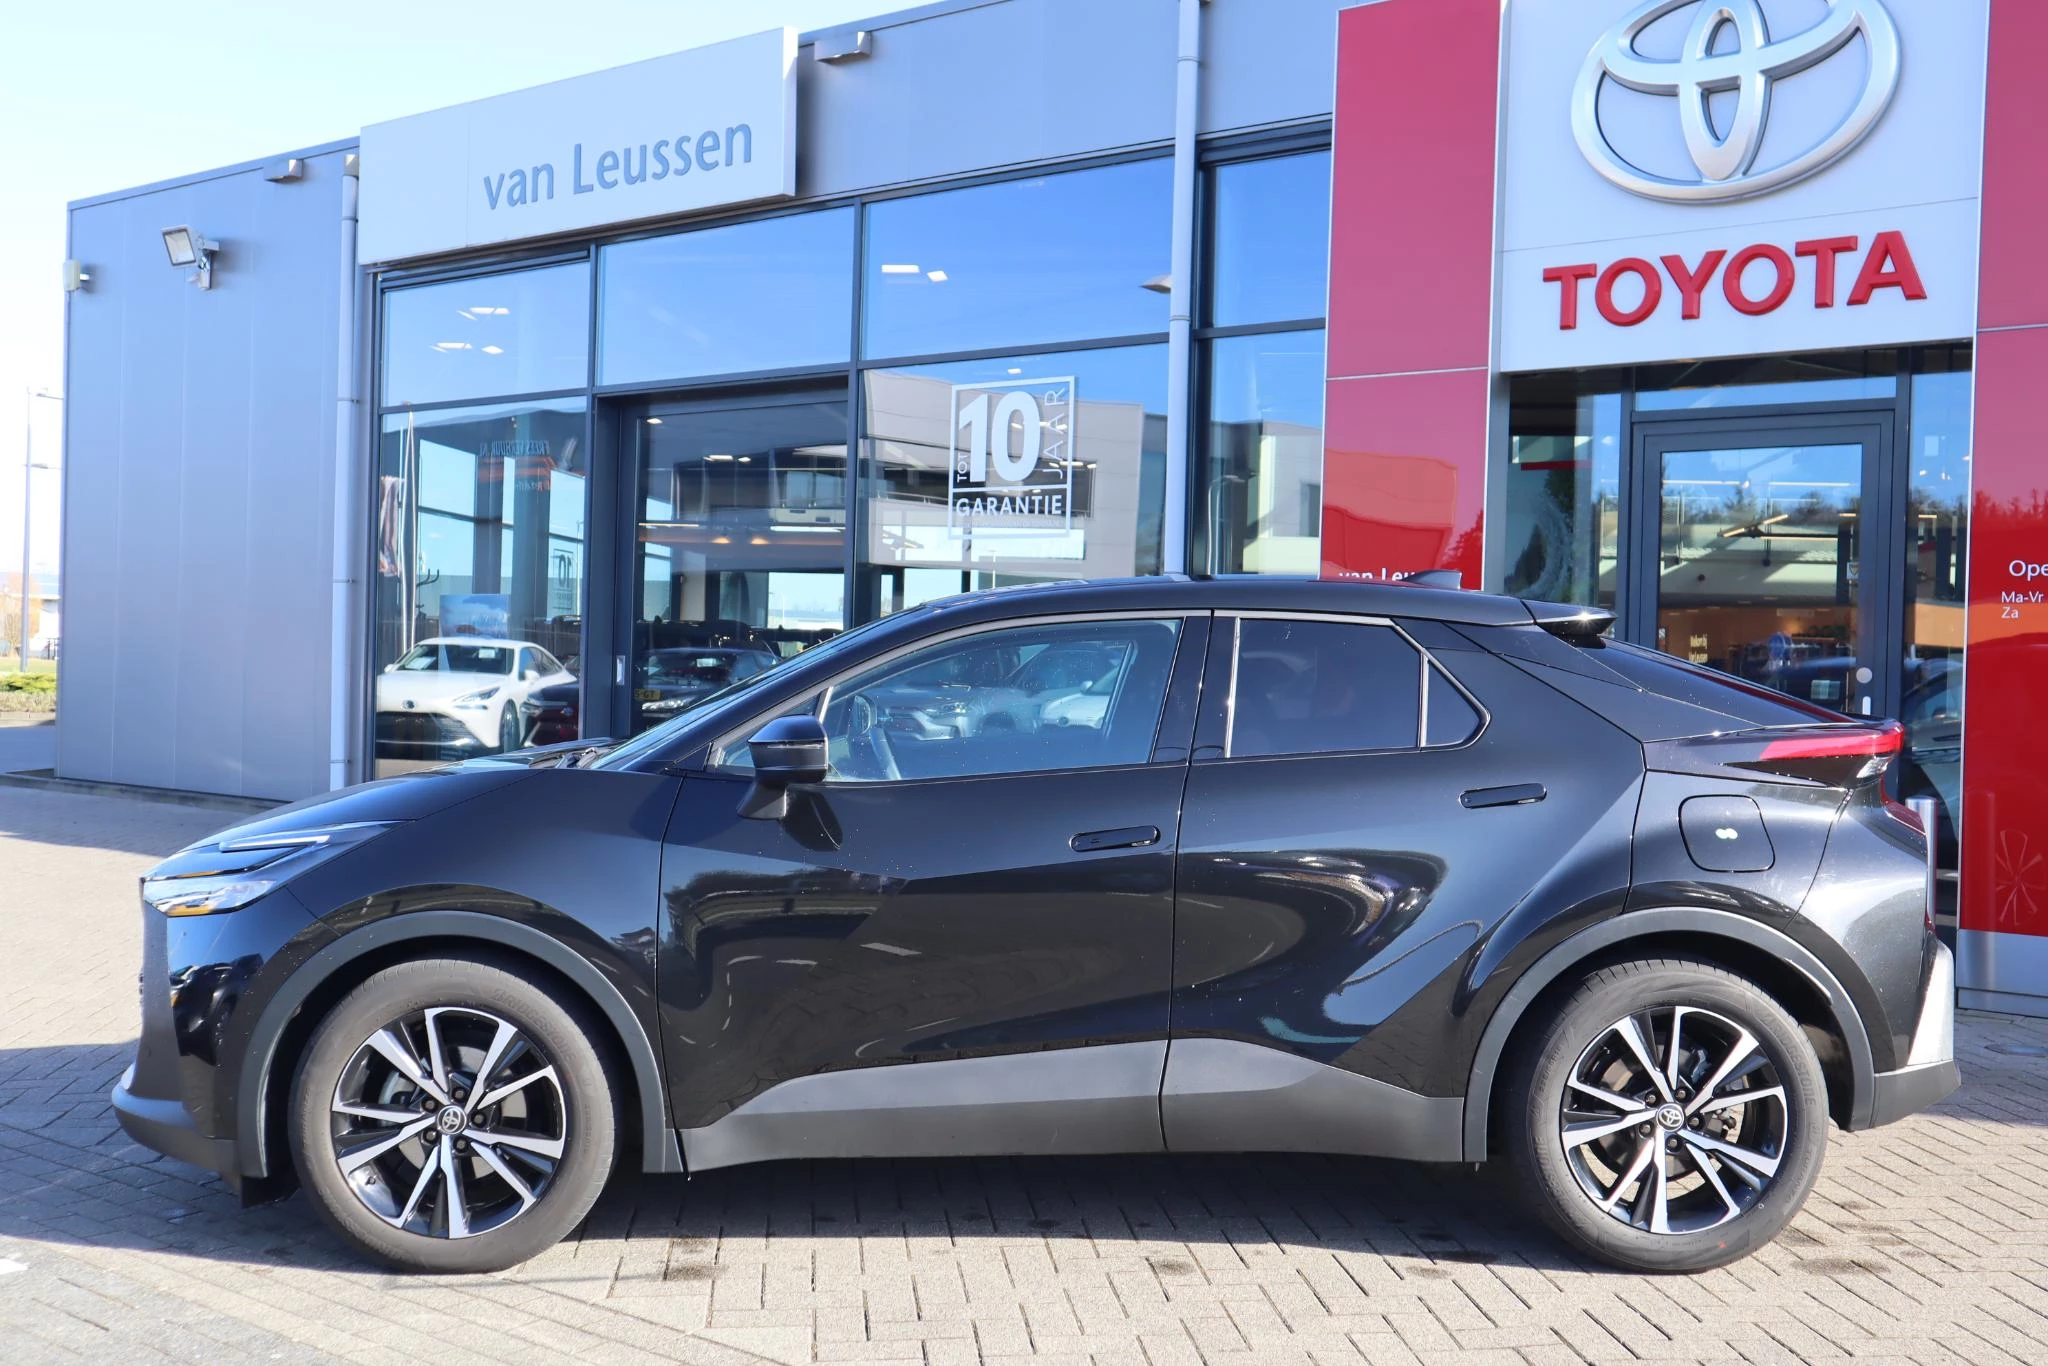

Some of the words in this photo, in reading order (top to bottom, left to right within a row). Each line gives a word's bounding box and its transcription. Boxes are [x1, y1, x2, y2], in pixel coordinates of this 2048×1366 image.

[484, 163, 554, 210] van
[573, 122, 752, 195] Leussen
[1543, 230, 1927, 331] TOYOTA
[959, 391, 1041, 482] 10
[1042, 387, 1065, 480] JAAR
[957, 453, 968, 483] TOT
[956, 494, 1062, 517] GARANTIE
[2001, 591, 2044, 603] Ma-Vr
[2001, 606, 2019, 619] Za
